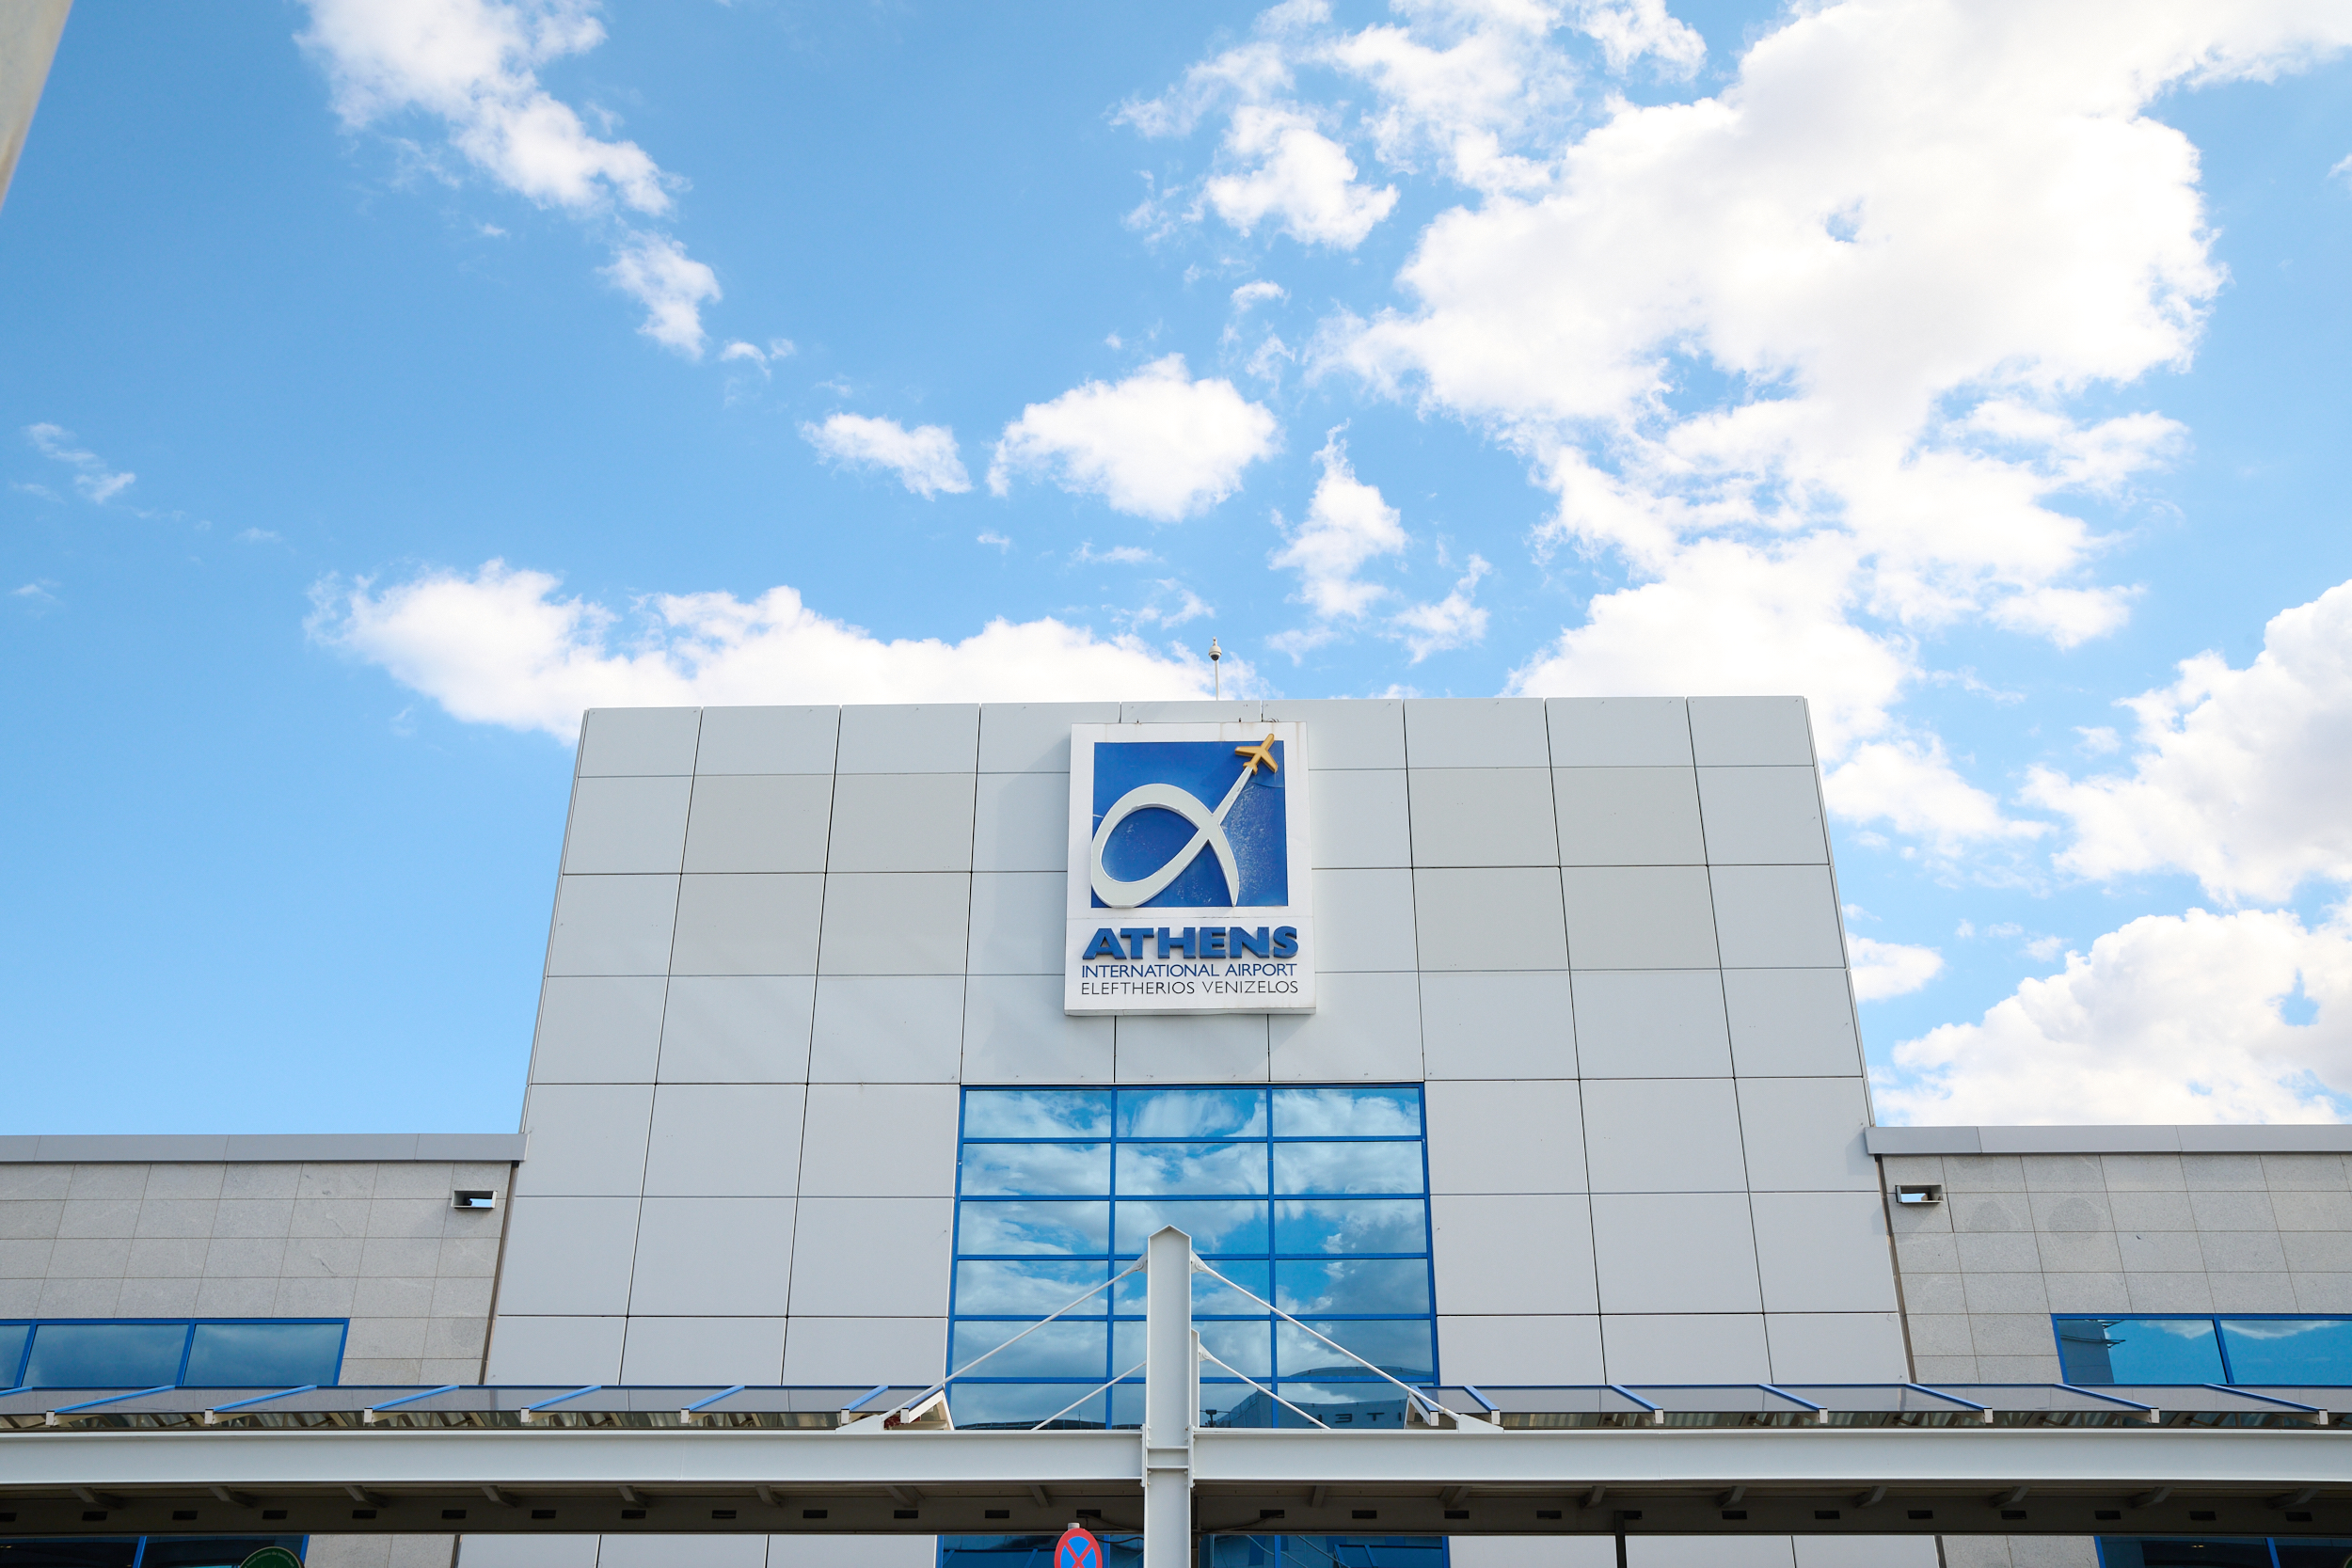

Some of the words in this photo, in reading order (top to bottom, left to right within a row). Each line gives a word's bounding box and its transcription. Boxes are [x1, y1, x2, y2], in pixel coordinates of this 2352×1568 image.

[1082, 926, 1299, 960] ATHENS
[1081, 963, 1220, 978] INTERNATIONAL
[1224, 962, 1298, 977] AIRPORT
[1081, 980, 1196, 995] ELEFTHERIOS
[1201, 980, 1298, 994] VENIZELOS
